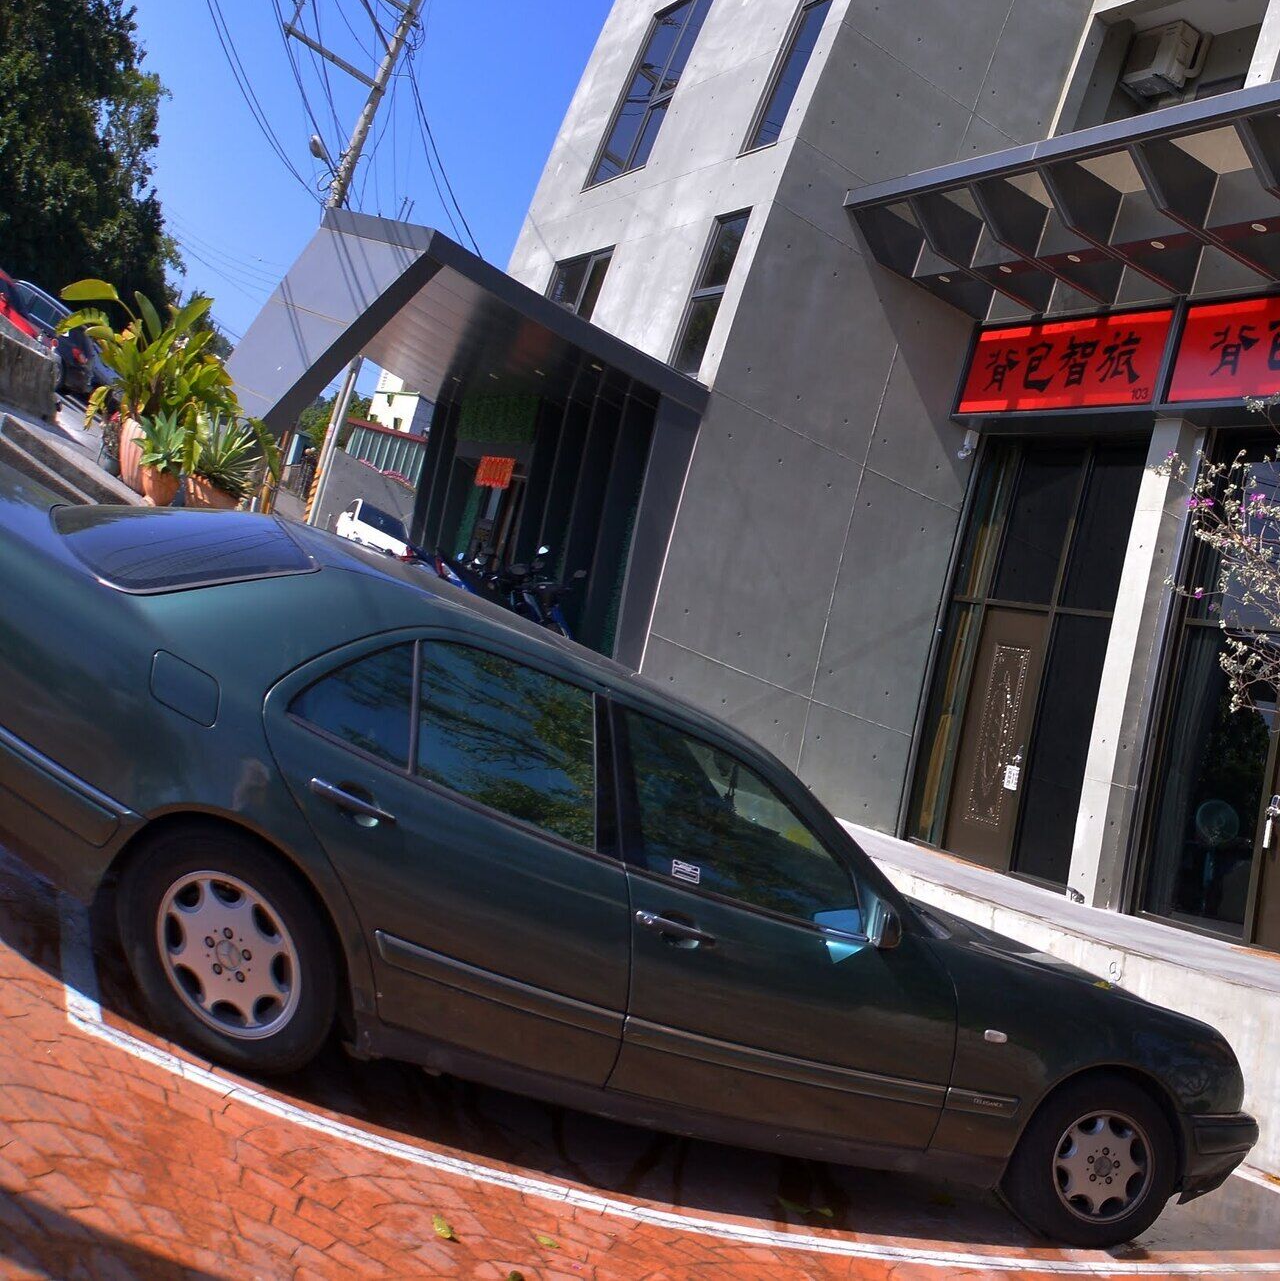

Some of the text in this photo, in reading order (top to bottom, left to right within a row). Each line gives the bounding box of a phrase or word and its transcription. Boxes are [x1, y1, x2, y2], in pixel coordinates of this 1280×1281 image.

[983, 331, 1141, 392] 背包智旅
[1132, 388, 1149, 400] 103
